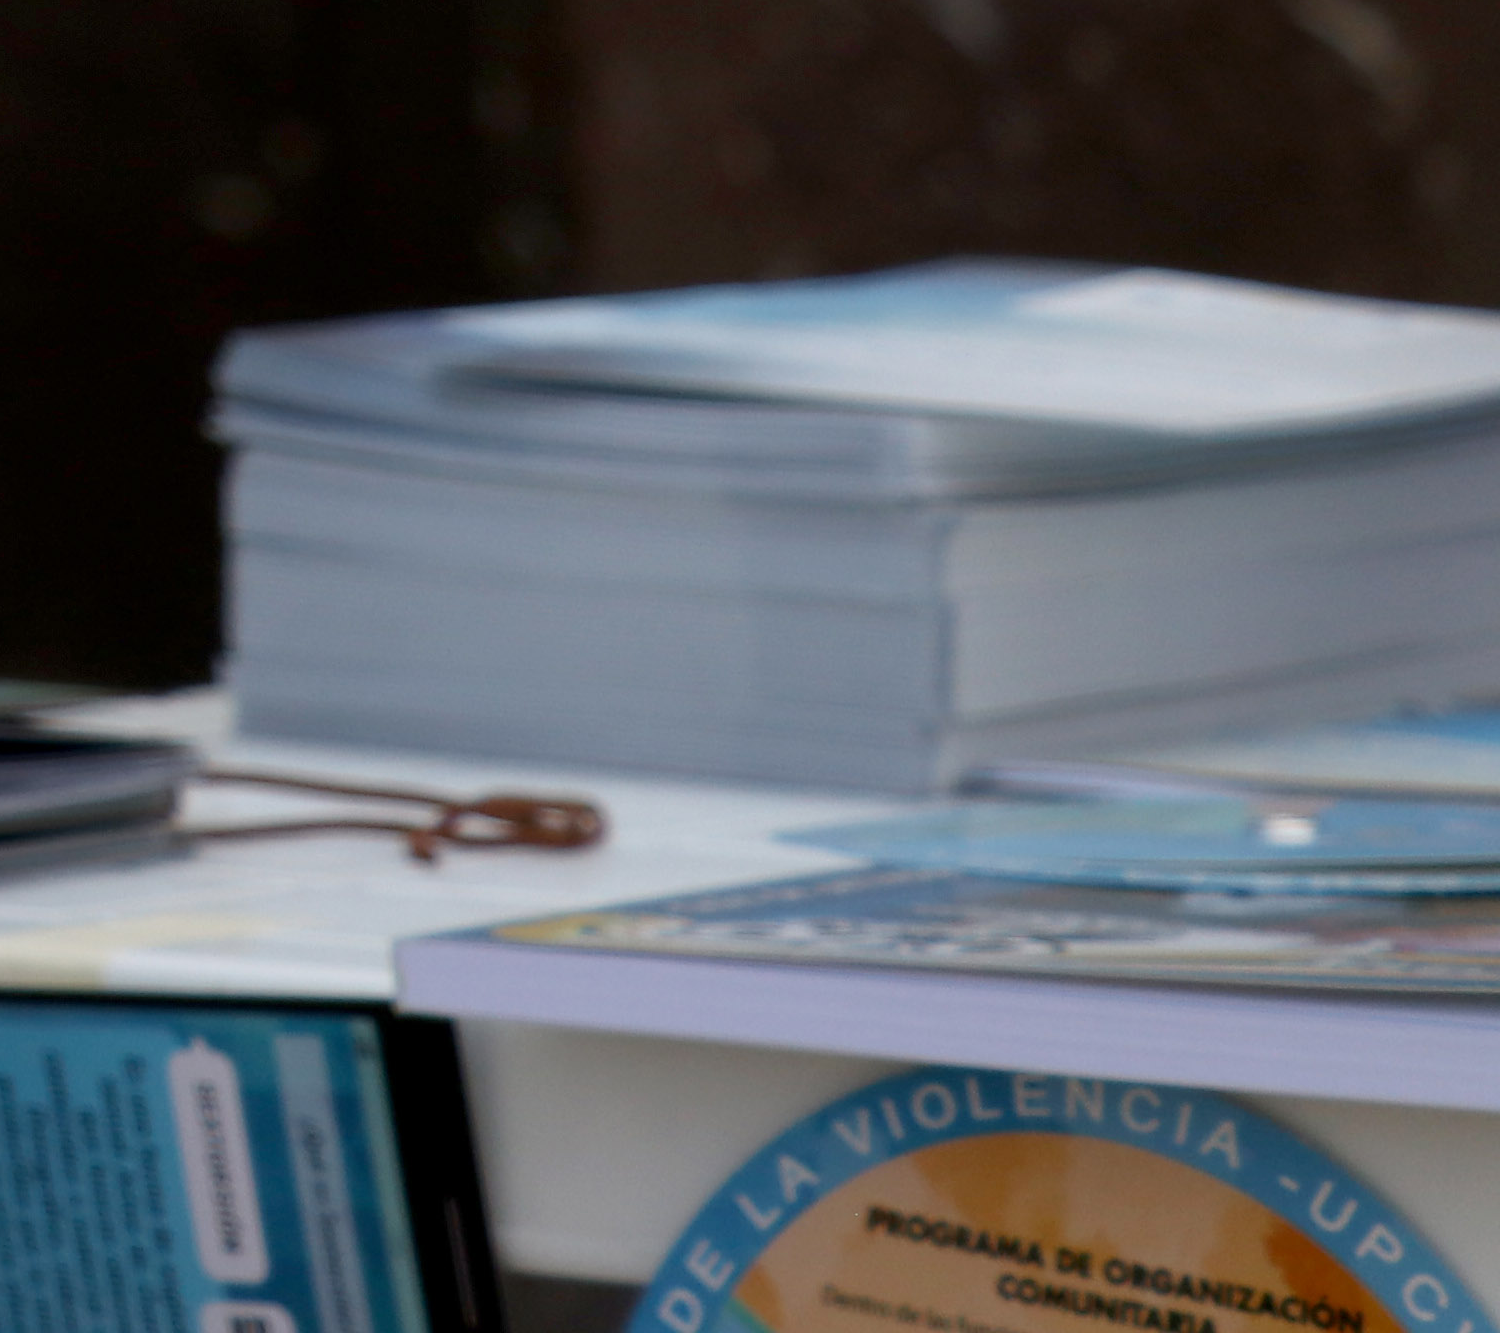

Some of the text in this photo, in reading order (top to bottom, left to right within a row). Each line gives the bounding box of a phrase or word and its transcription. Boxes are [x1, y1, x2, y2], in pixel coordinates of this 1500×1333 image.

[658, 1238, 734, 1333] DE
[736, 1154, 821, 1231] LA
[830, 1073, 1241, 1169] VIOLENCIA
[866, 1203, 1365, 1333] PROGRAMA DE ORGANIZACIÓN
[996, 1273, 1218, 1333] COMUNITARIA
